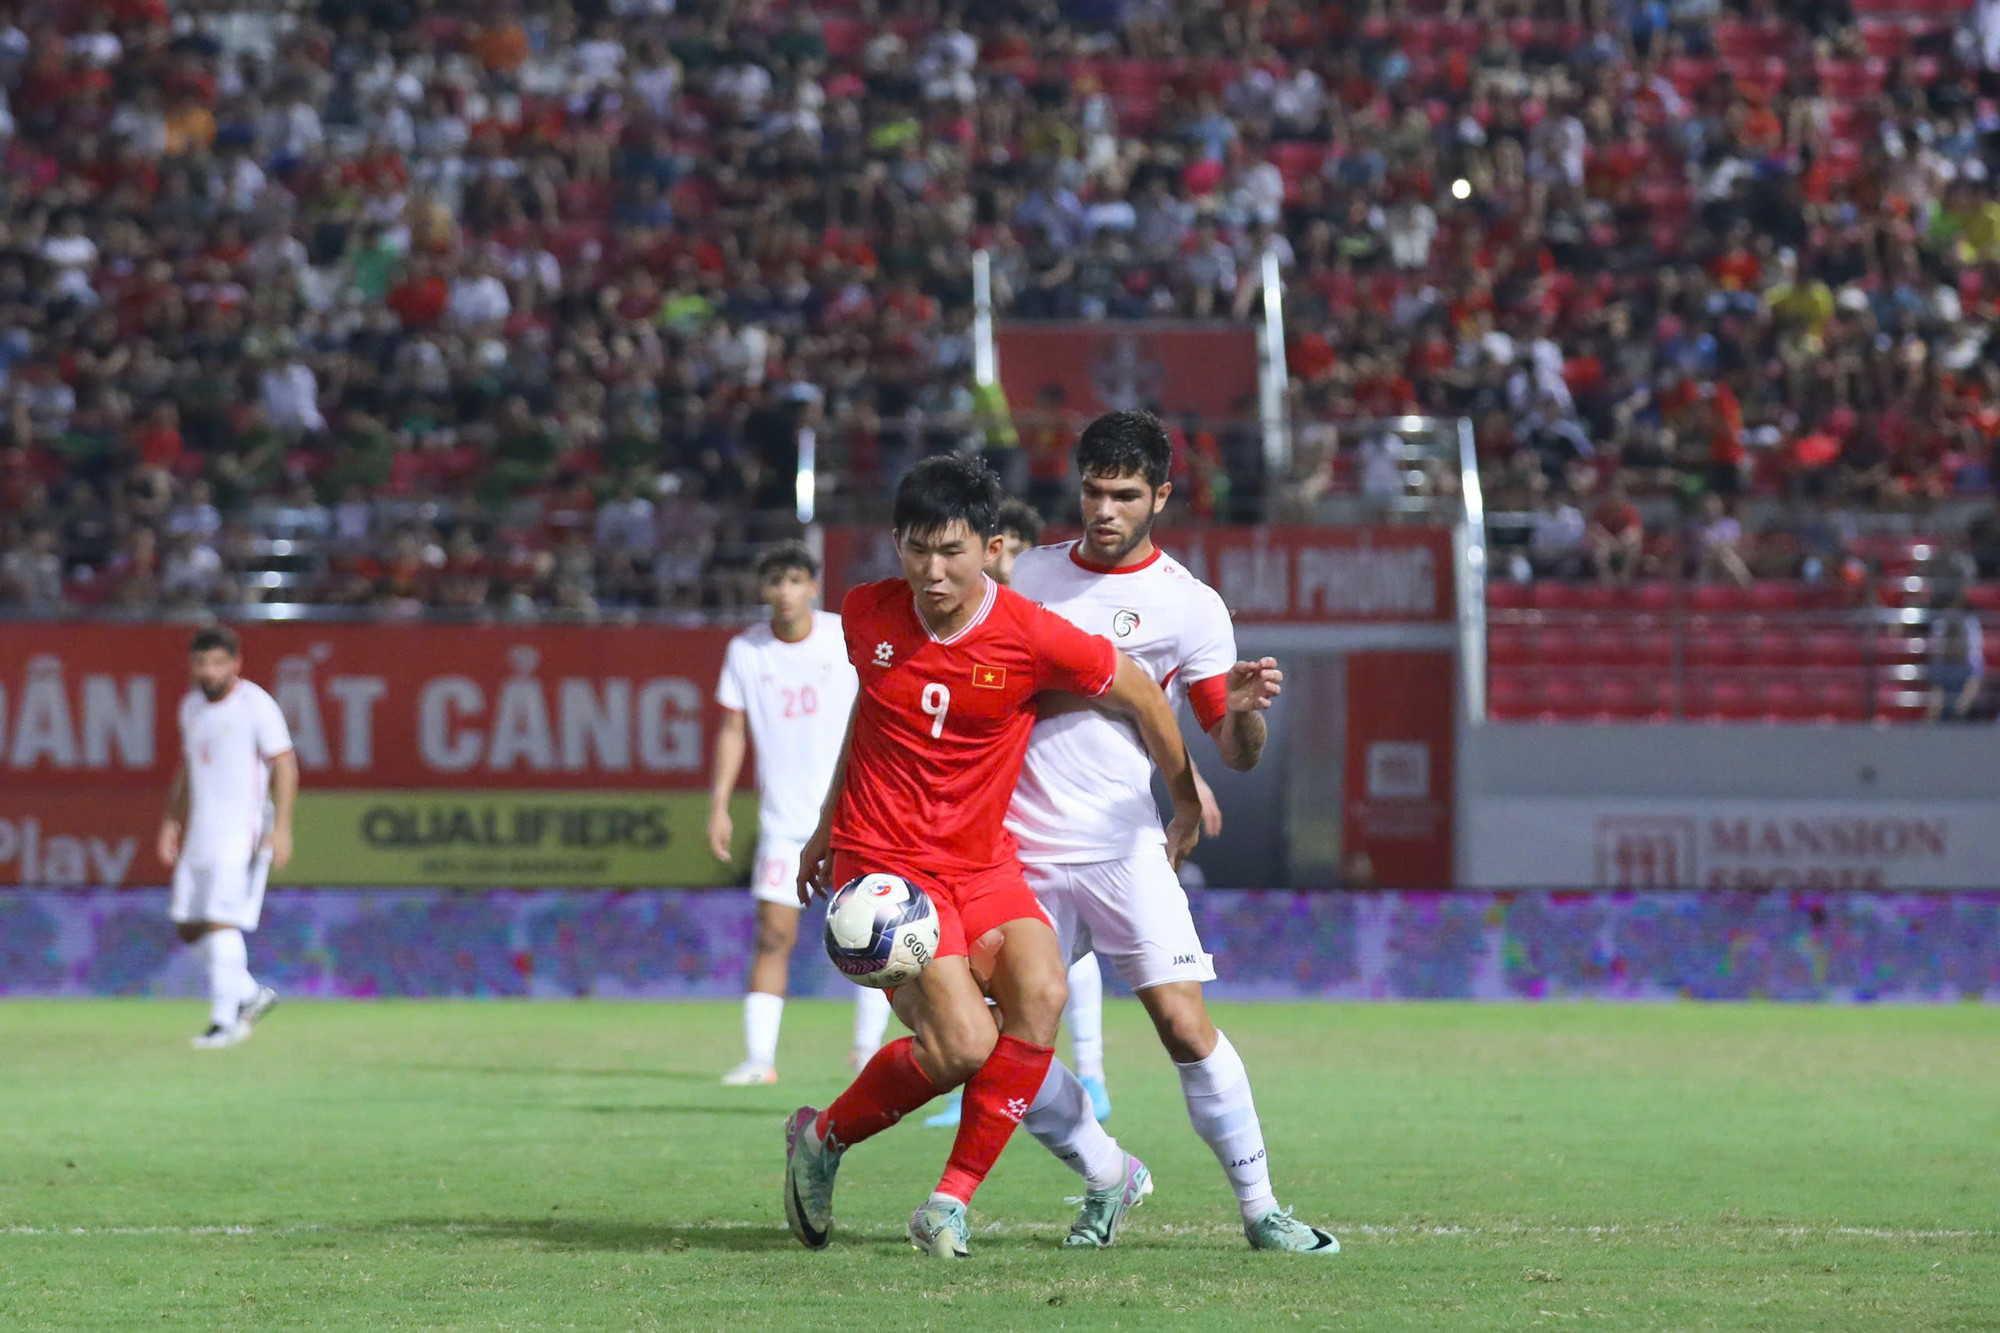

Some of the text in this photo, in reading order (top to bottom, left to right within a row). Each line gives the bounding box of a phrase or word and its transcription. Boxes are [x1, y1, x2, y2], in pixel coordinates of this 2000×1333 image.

[0, 643, 702, 772] ÂN ẤT CẢNG
[781, 684, 817, 719] 20
[921, 682, 951, 739] 9
[361, 806, 671, 849] QUALIFIERS
[1231, 1149, 1265, 1168] JAKO
